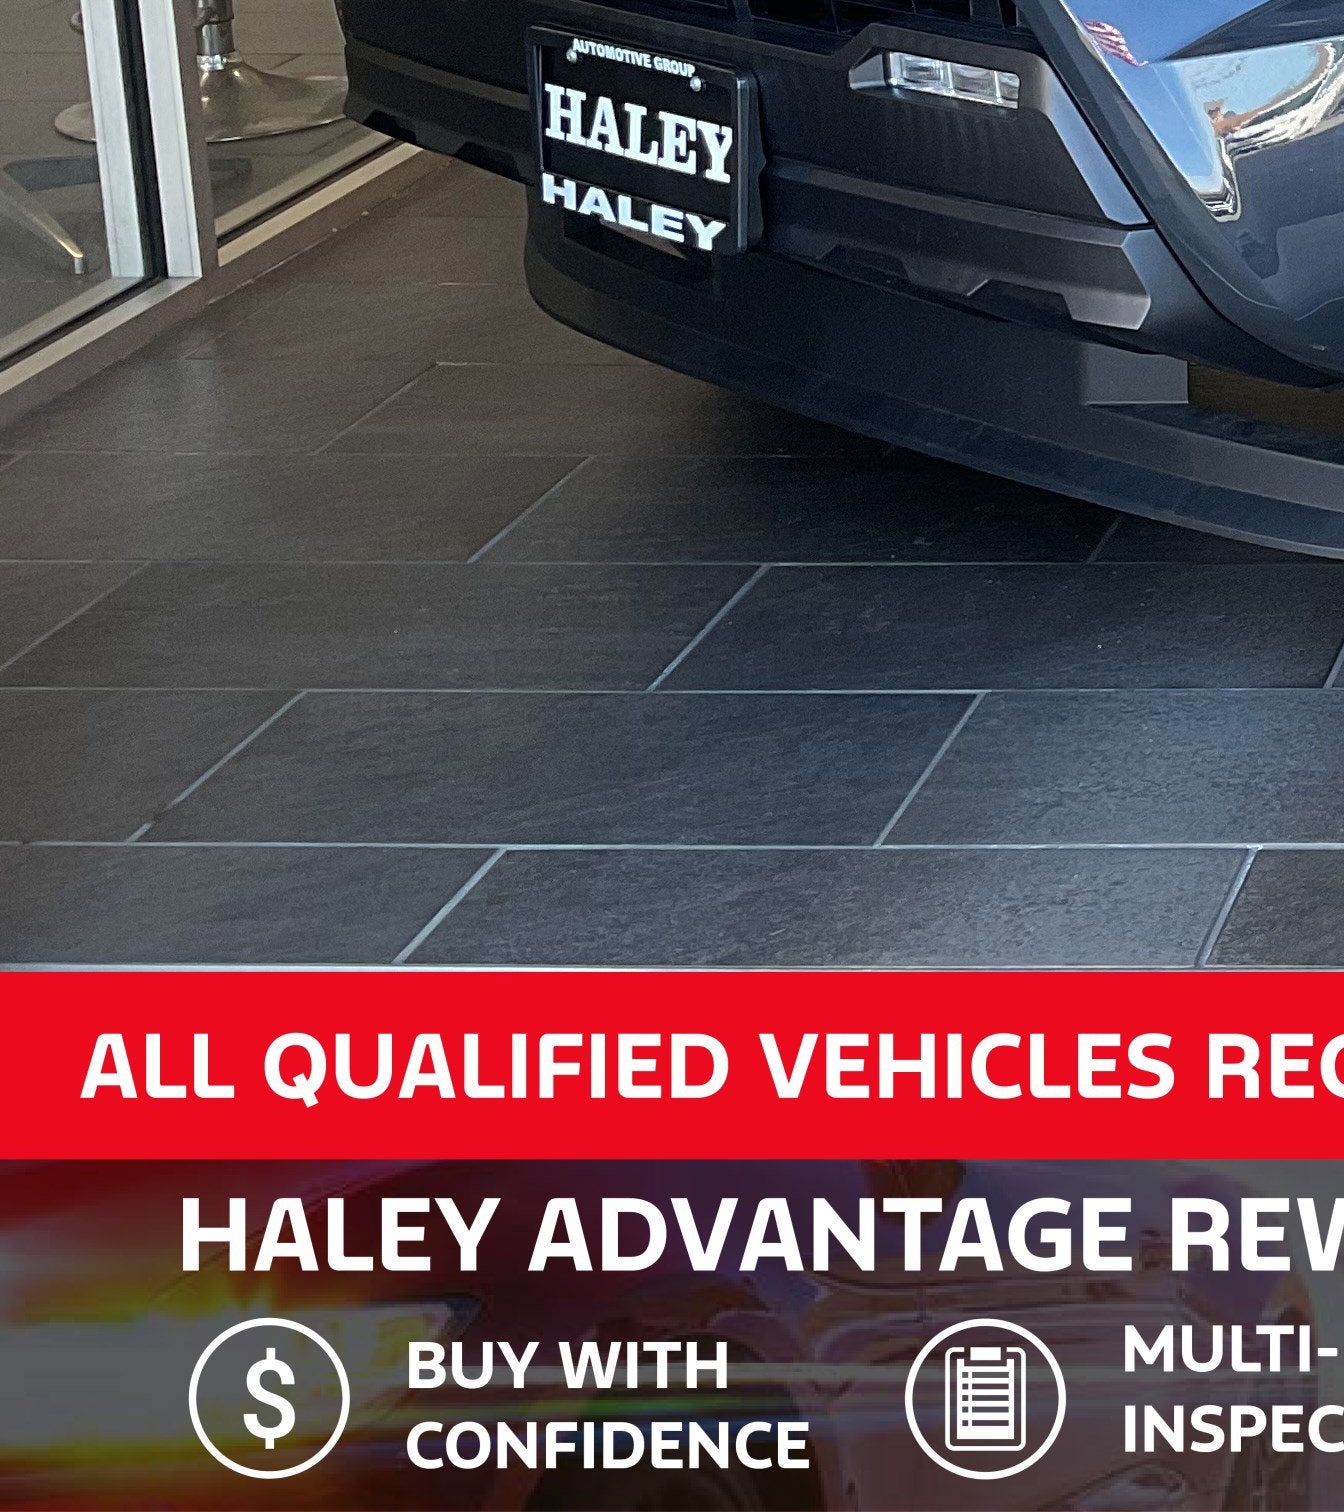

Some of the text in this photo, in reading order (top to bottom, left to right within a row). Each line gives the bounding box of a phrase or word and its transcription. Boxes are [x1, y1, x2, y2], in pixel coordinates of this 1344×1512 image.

[572, 38, 696, 78] AUTOMOTIVE GROUP
[544, 83, 733, 183] HALEY
[541, 172, 727, 251] HALEY
